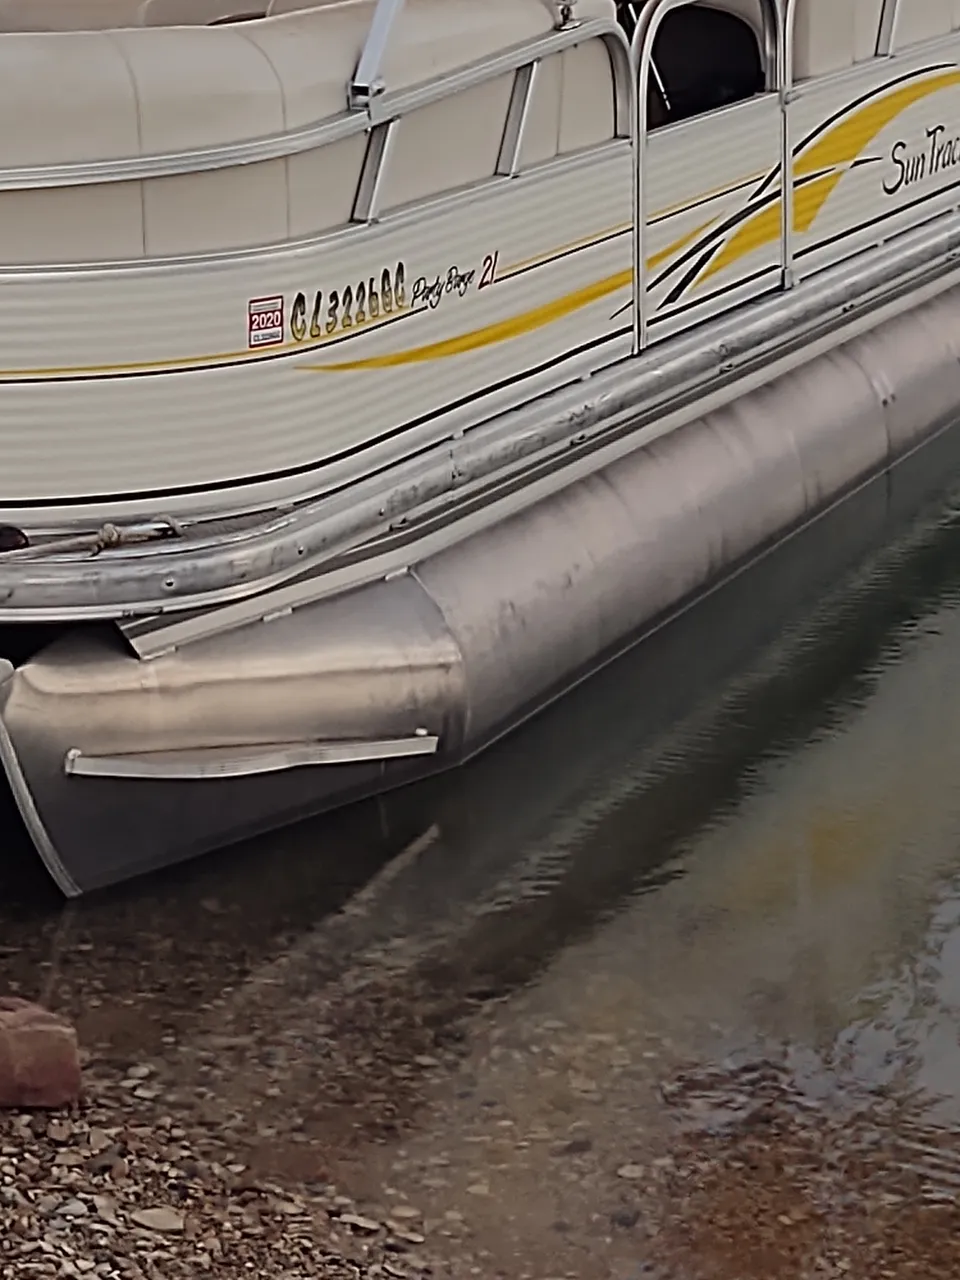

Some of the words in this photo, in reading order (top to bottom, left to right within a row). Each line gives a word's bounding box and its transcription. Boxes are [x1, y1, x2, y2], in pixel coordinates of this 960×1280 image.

[882, 125, 960, 195] SunTrac
[478, 250, 498, 290] 21
[251, 311, 281, 330] 2020
